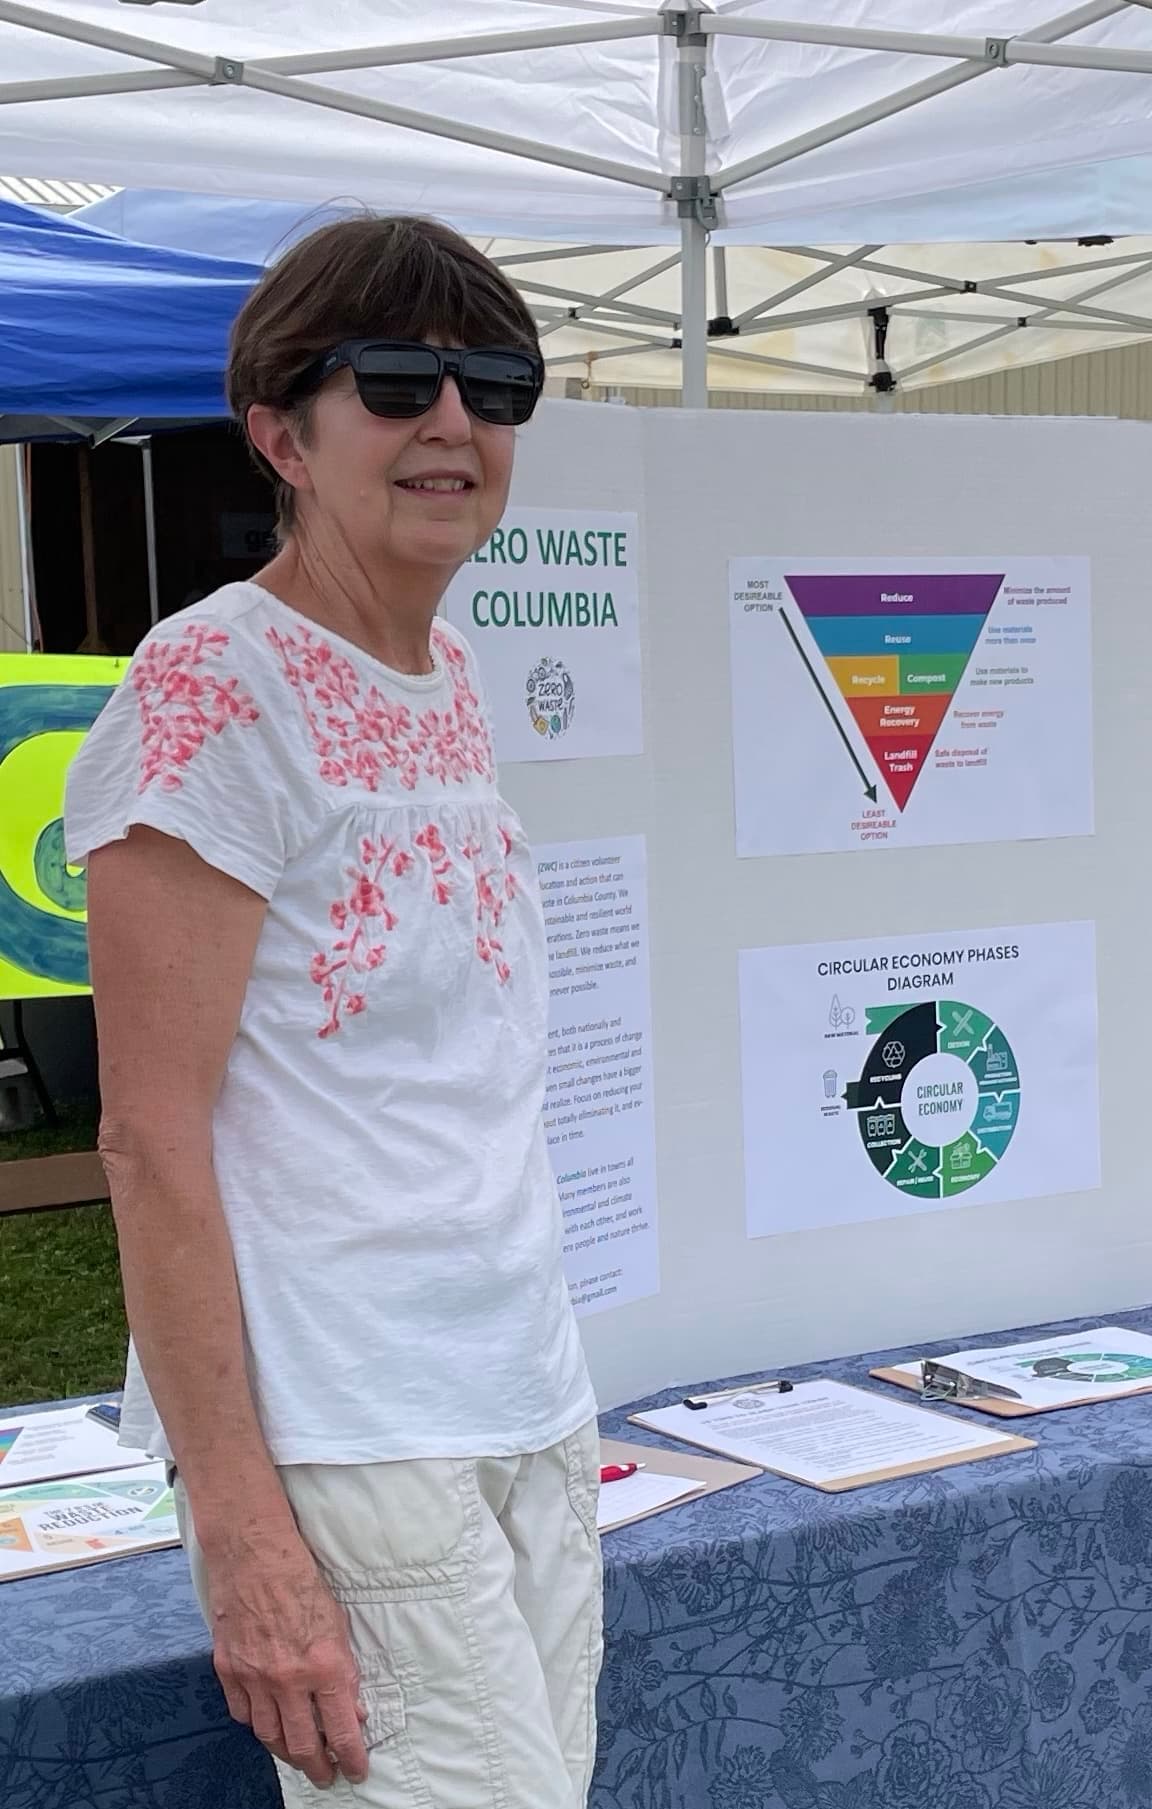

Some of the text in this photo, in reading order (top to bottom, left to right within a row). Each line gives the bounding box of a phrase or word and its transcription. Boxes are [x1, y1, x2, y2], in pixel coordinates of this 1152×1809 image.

[536, 528, 627, 567] WASTE
[746, 580, 769, 589] MOST
[734, 591, 783, 602] DESIREABLE
[880, 593, 914, 603] Reduce
[472, 590, 618, 628] COLUMBIA
[743, 603, 774, 612] OPTION
[884, 634, 912, 644] Reuse
[851, 673, 946, 686] Recycle Compost
[884, 705, 915, 717] Energy
[879, 717, 920, 728] Recovery
[884, 750, 918, 761] Landfill
[888, 762, 913, 773] Trash
[862, 809, 886, 819] LEAST
[851, 820, 897, 829] DESIREABLE
[860, 831, 888, 841] OPTION
[817, 945, 1019, 977] CIRCULAR ECONOMY PHASES
[887, 972, 954, 992] DIAGRAM
[916, 1081, 964, 1100] CIRCULAR
[918, 1098, 963, 1117] ECONOMY
